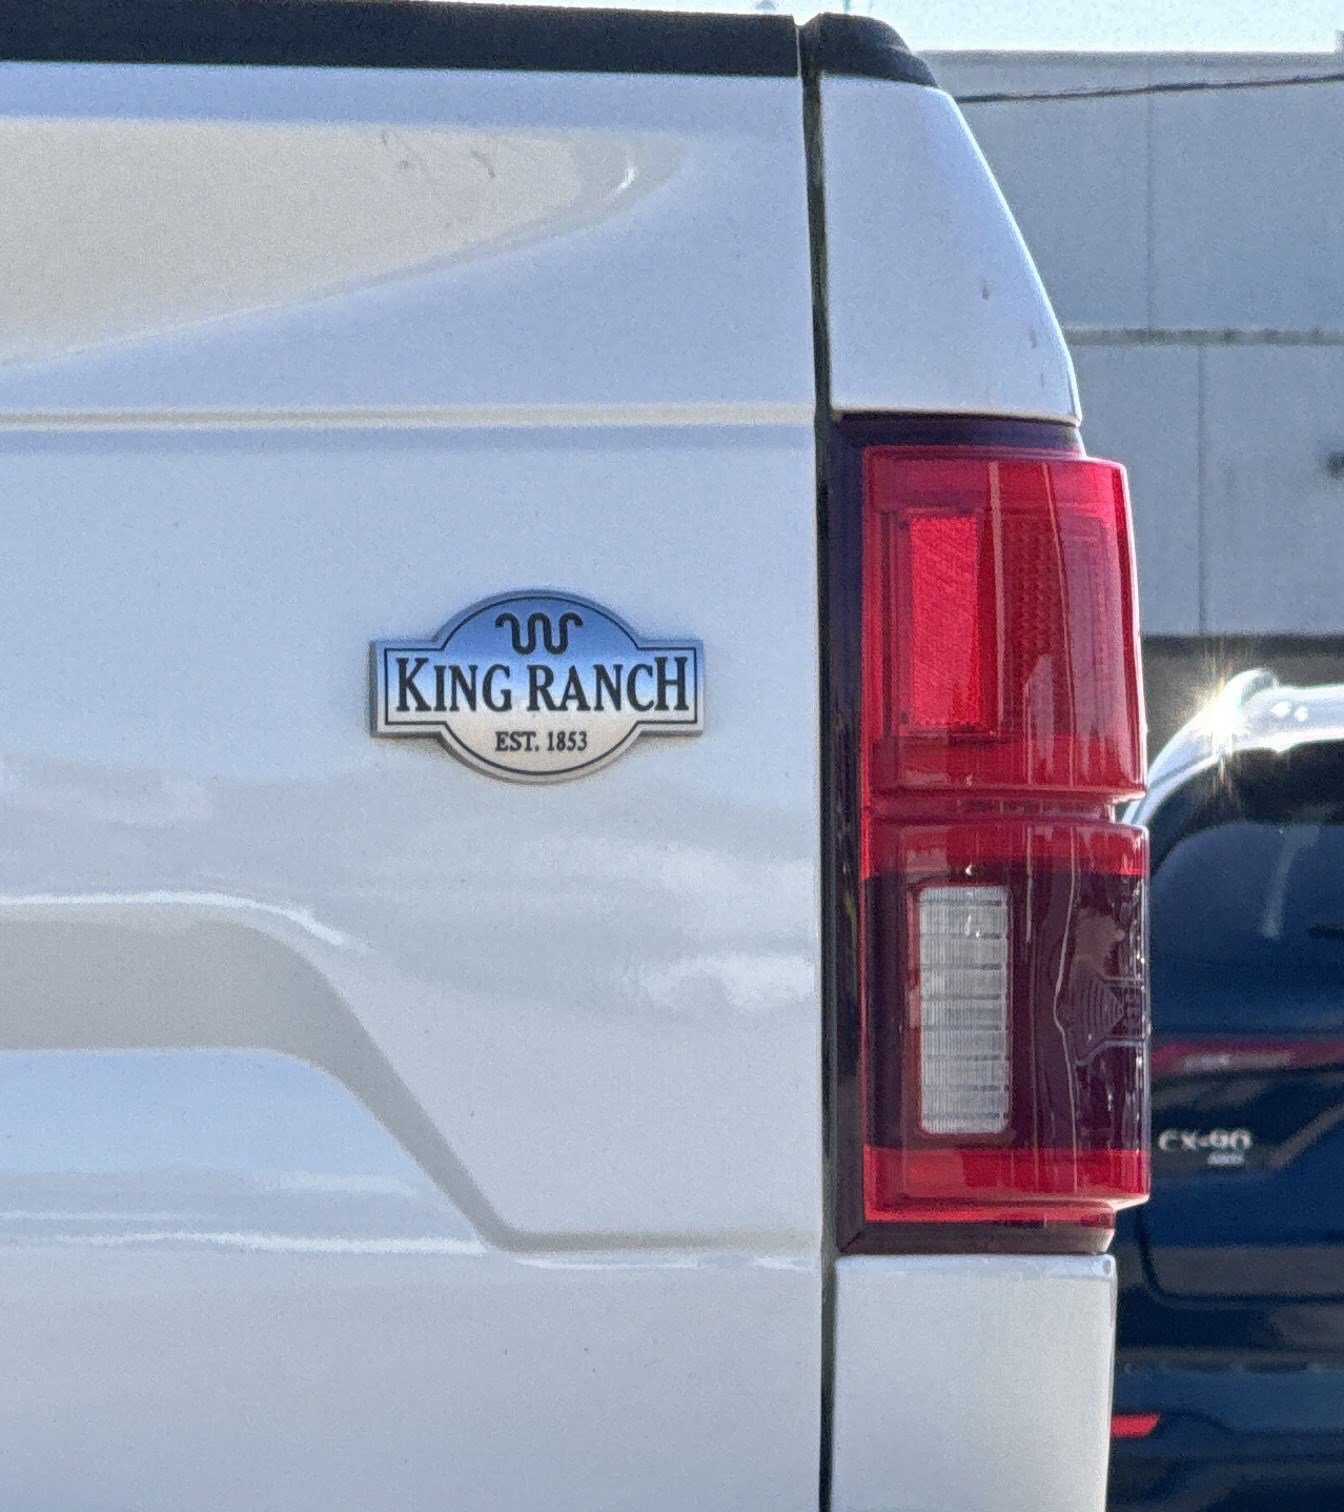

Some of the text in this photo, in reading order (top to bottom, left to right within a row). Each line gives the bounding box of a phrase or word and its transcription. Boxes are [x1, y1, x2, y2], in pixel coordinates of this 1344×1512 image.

[396, 656, 690, 712] KING RANCH
[495, 730, 588, 751] EST. 1853
